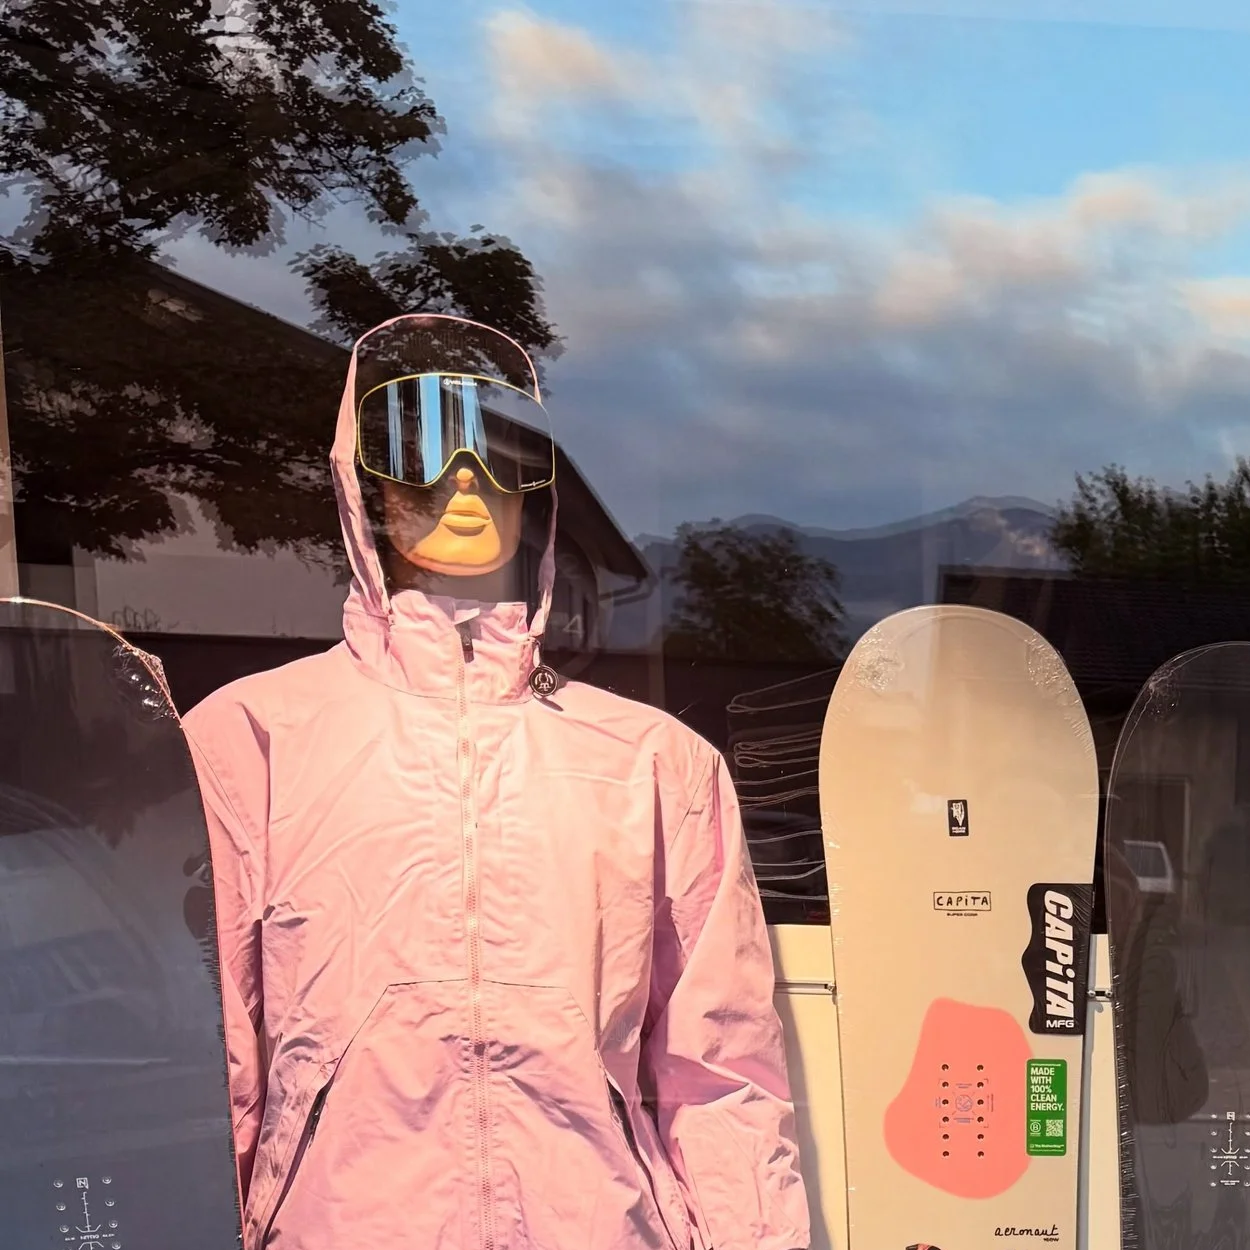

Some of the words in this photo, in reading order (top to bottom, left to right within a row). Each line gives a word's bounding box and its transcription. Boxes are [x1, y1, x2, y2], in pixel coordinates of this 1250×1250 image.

[1045, 1019, 1075, 1028] MFG
[1030, 1067, 1055, 1076] MADE
[1030, 1076, 1052, 1085] WITH
[1030, 1085, 1052, 1093] 100%
[1030, 1094, 1057, 1102] CLEAN
[1030, 1103, 1065, 1111] ENERGY.
[994, 1224, 1059, 1236] aeronaut
